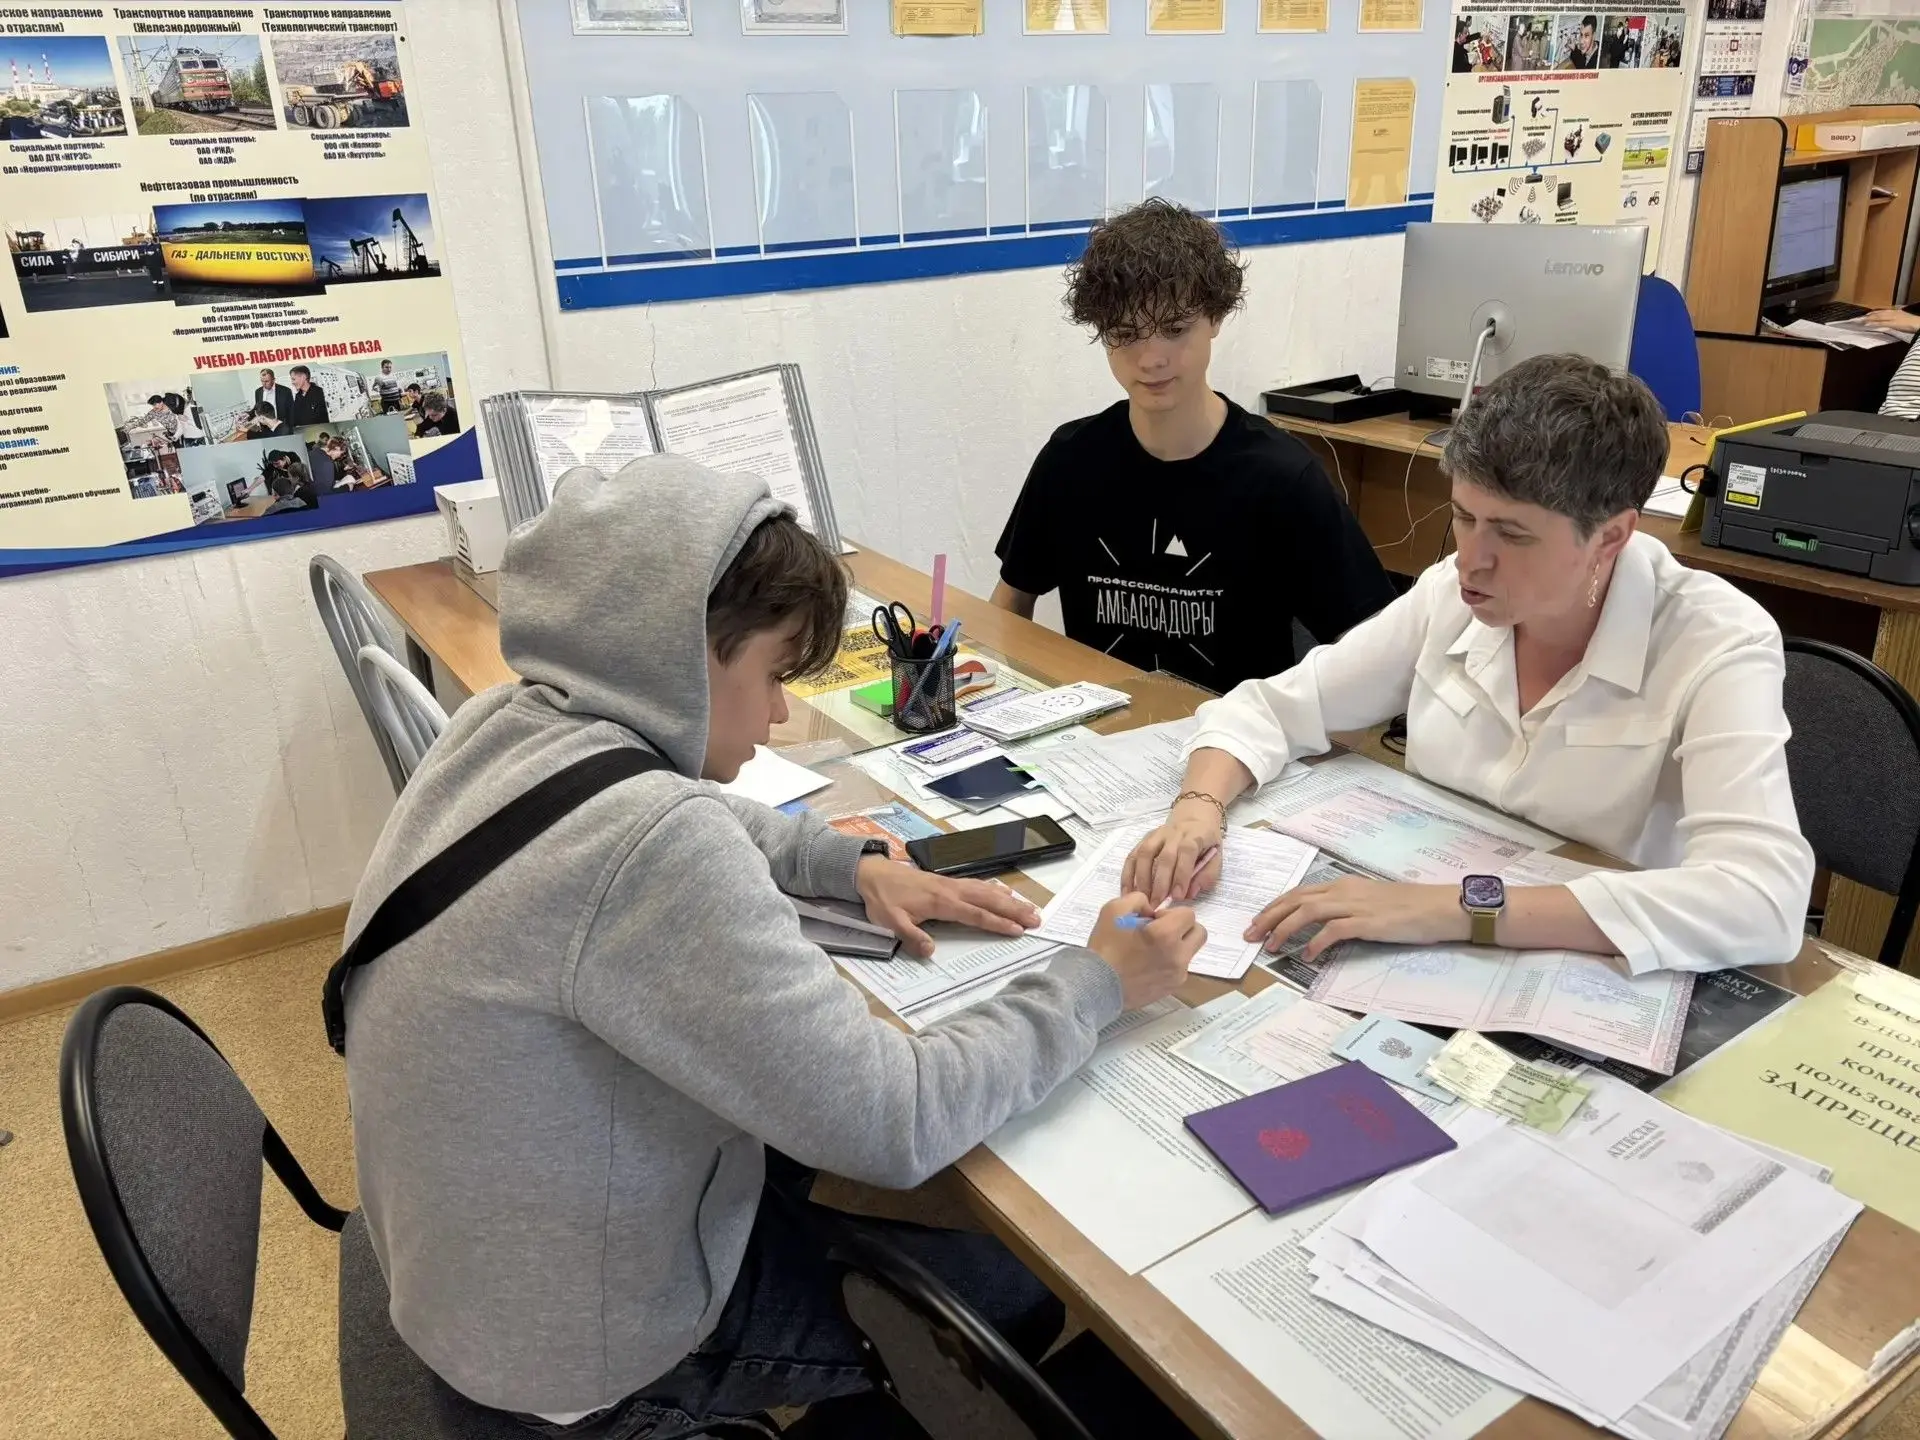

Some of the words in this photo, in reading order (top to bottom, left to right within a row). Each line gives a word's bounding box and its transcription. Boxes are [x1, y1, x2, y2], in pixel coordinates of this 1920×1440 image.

[30, 9, 103, 18] направление
[113, 8, 187, 18] Транспортное
[188, 9, 253, 19] направление
[263, 8, 330, 19] Транспортное
[331, 9, 391, 19] направление
[6, 22, 64, 33] отраслям)
[134, 22, 241, 33] (Железнодорожный)
[262, 22, 347, 32] (Технологический
[349, 23, 398, 32] транспорт)
[169, 136, 217, 146] Социальные
[218, 135, 256, 144] партнеры:
[1831, 135, 1856, 143] Canon
[10, 143, 62, 153] Социальные
[63, 142, 105, 151] партнеры:
[29, 154, 44, 162] ОАО
[3, 165, 19, 174] ОАО
[141, 180, 211, 193] Нефтегазовая
[211, 175, 299, 190] промышленность
[208, 190, 257, 203] отраслям)
[21, 255, 54, 267] СИЛА
[94, 249, 140, 263] СИБИРИ
[171, 250, 187, 258] ГАЗ
[196, 250, 251, 260] ДАЛЬНЕМУ
[256, 252, 310, 262] ВОСТОКУ!
[1544, 258, 1604, 276] Lenovo
[212, 304, 257, 314] Социальные
[259, 301, 295, 310] партнеры:
[202, 332, 259, 343] магистральные
[194, 343, 348, 369] УЧЕБНО-ЛАБОРАТОРНАЯ
[350, 339, 382, 355] БАЗА
[15, 374, 66, 385] образования
[9, 385, 58, 396] реализации
[12, 425, 49, 434] обучение
[44, 494, 84, 504] дуального
[85, 487, 120, 498] обучения
[1088, 575, 1224, 597] ПРОФЕССИОНАЛИТЕТ
[1096, 589, 1215, 639] АМБАССАДОРЫ
